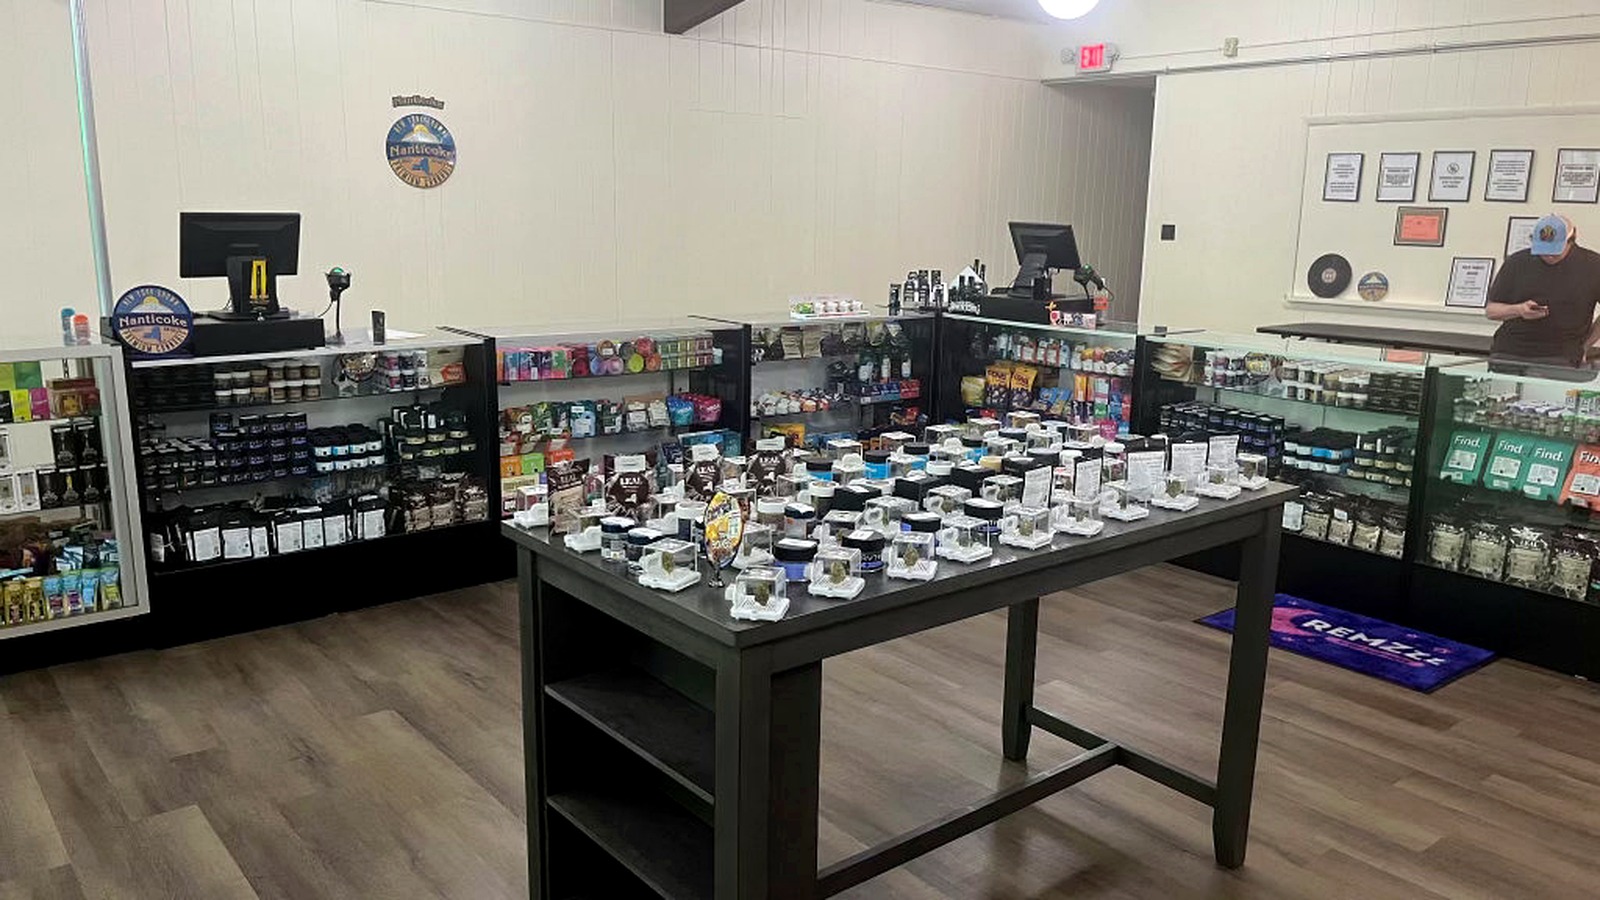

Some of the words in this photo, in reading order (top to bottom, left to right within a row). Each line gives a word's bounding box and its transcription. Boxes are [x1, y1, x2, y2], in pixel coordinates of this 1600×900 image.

[1081, 45, 1104, 68] EXIT
[390, 144, 455, 159] Nanticoke
[119, 314, 188, 328] Nanticoke
